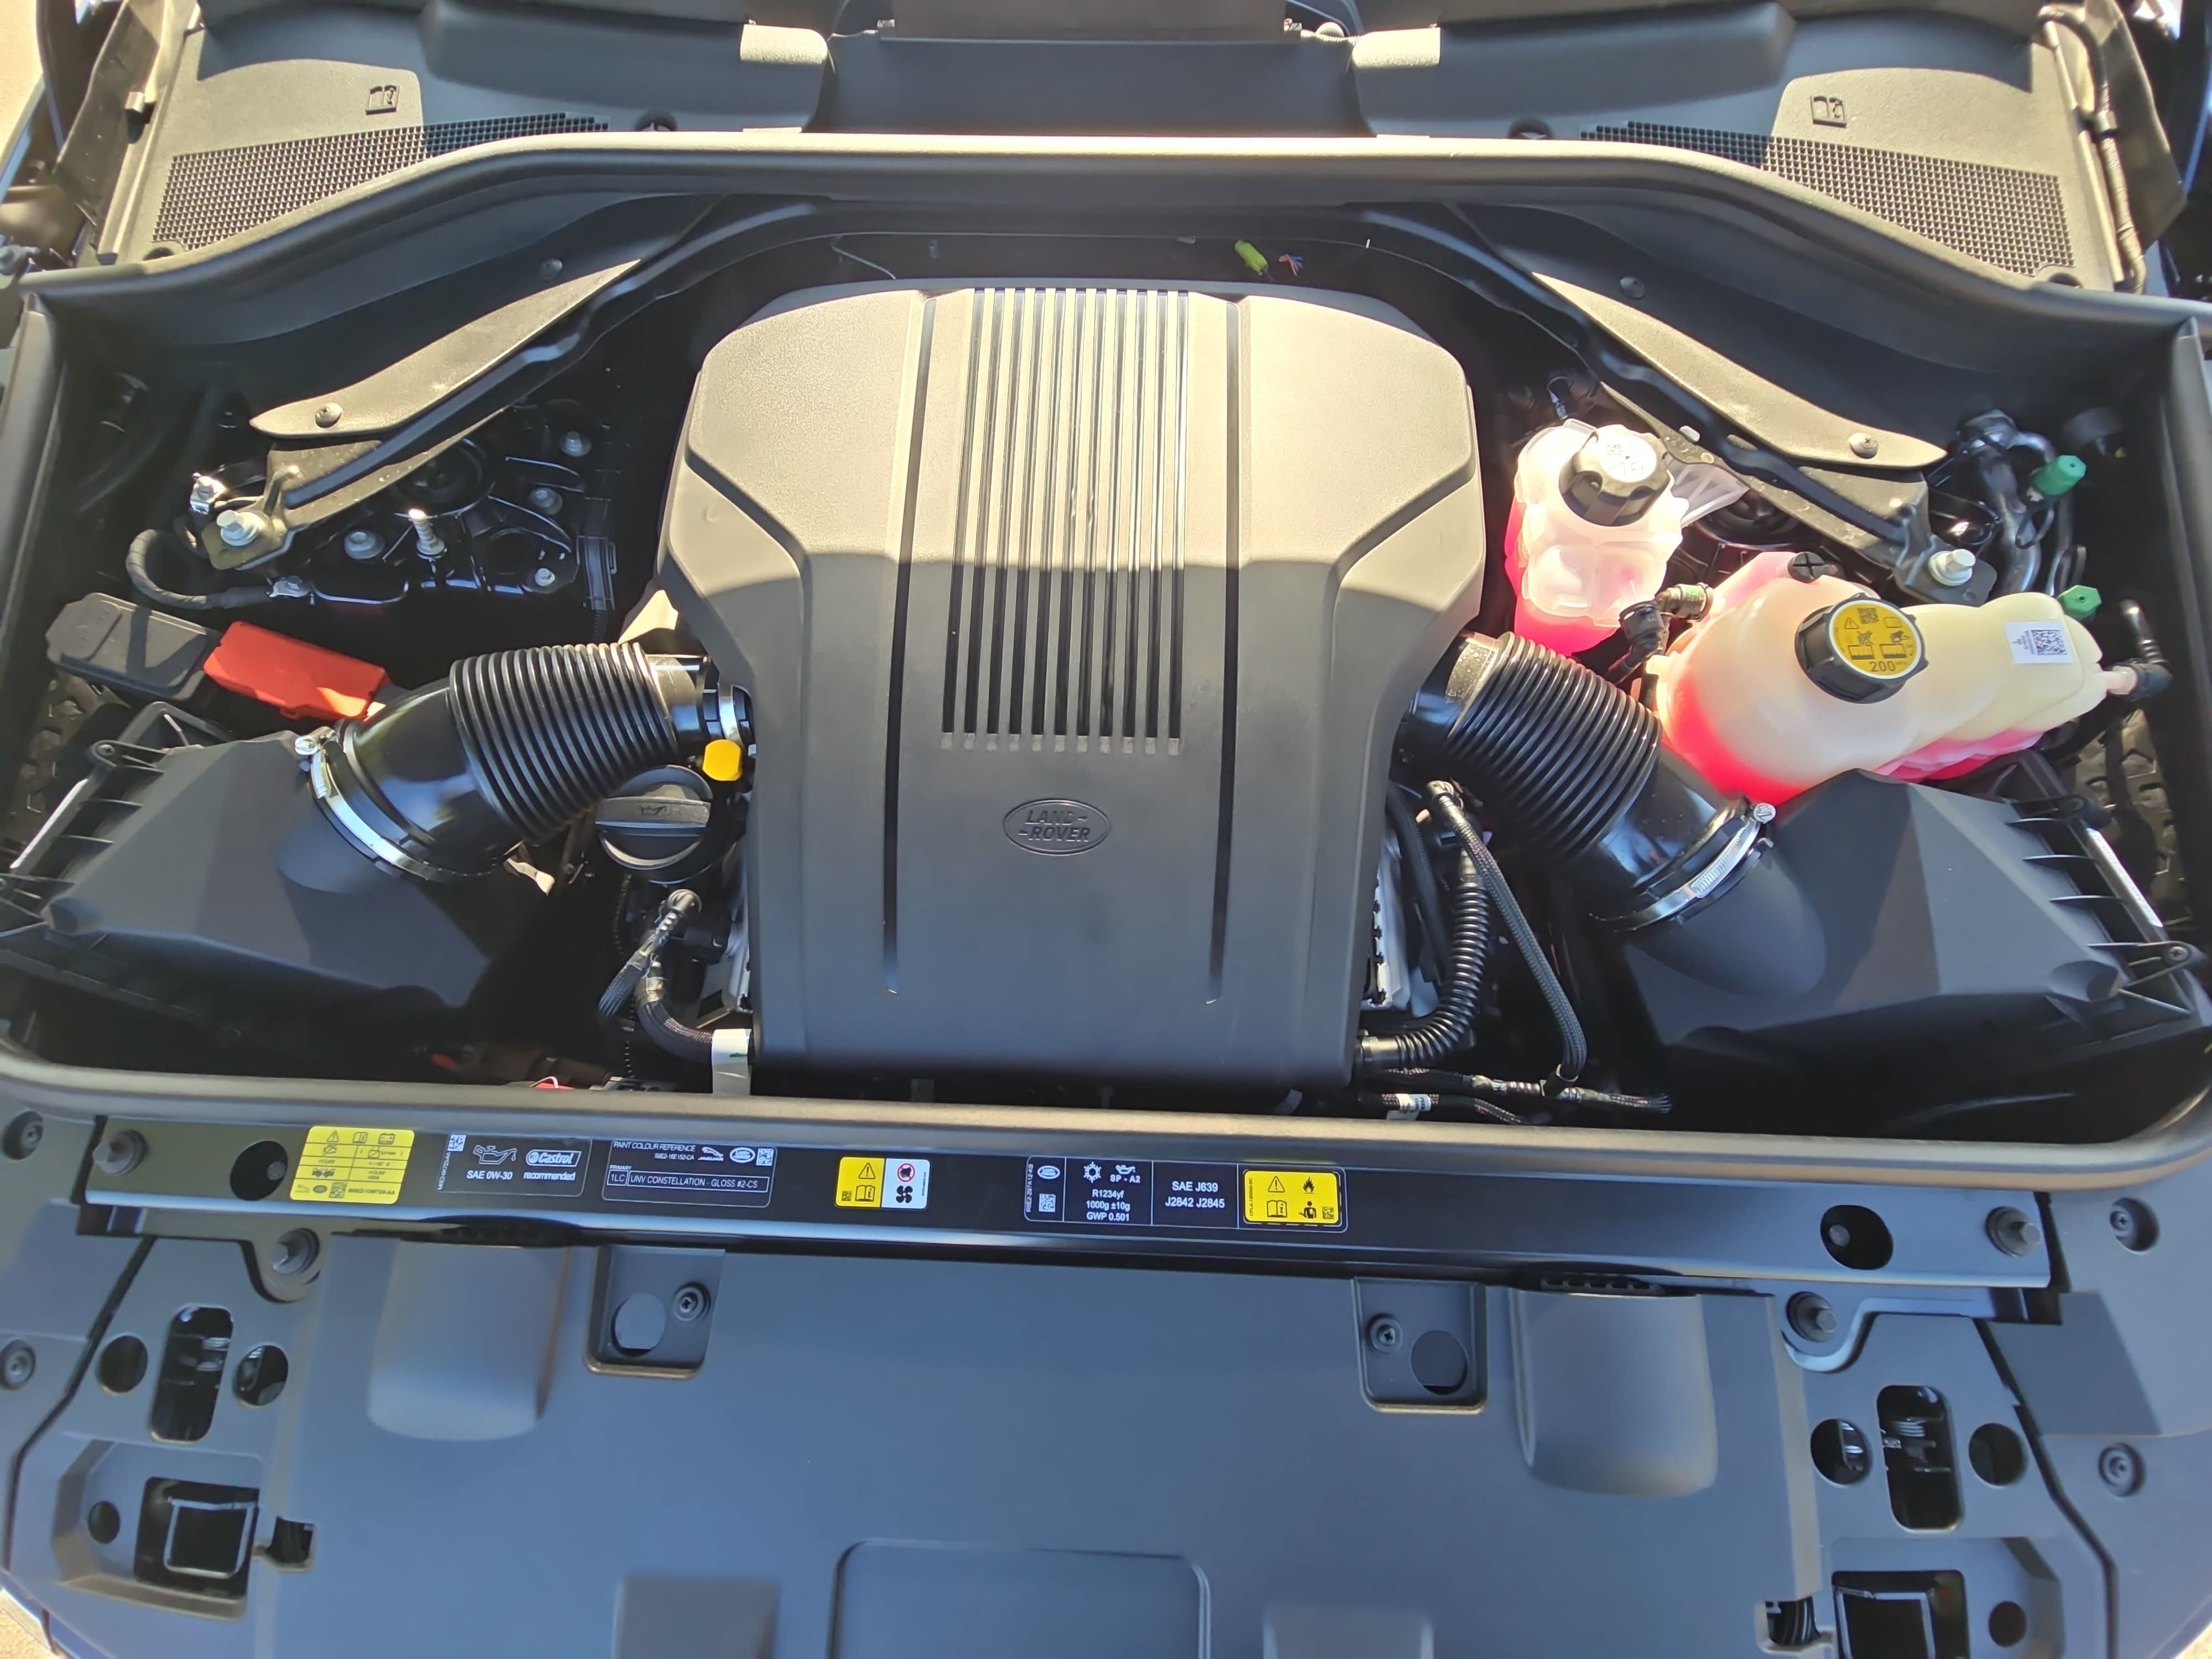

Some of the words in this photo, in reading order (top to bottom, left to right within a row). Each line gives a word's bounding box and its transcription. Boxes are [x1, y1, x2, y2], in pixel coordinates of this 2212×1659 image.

[1869, 661, 1896, 672] 200
[632, 1142, 658, 1150] COLOUR
[659, 1144, 696, 1152] REFERENCE
[538, 1152, 573, 1164] Castrol
[466, 1170, 485, 1179] SAE
[486, 1171, 513, 1180] 0W-30
[523, 1172, 576, 1181] recommended
[611, 1173, 625, 1182] 1LC
[1110, 1175, 1122, 1183] SP
[1129, 1175, 1141, 1183] A2
[630, 1175, 645, 1183] UNV
[647, 1176, 706, 1186] CONSTELLATION
[711, 1178, 735, 1187] GLOSS
[1172, 1181, 1193, 1191] SAE
[1195, 1182, 1218, 1192] J639
[1092, 1189, 1124, 1199] R1234yf
[1086, 1200, 1109, 1211] 1000g
[1110, 1202, 1131, 1212] ±10g
[1165, 1197, 1194, 1208] J2842
[1196, 1198, 1225, 1208] J2845
[1087, 1212, 1107, 1220] GWP
[1108, 1213, 1130, 1222] 0.501
